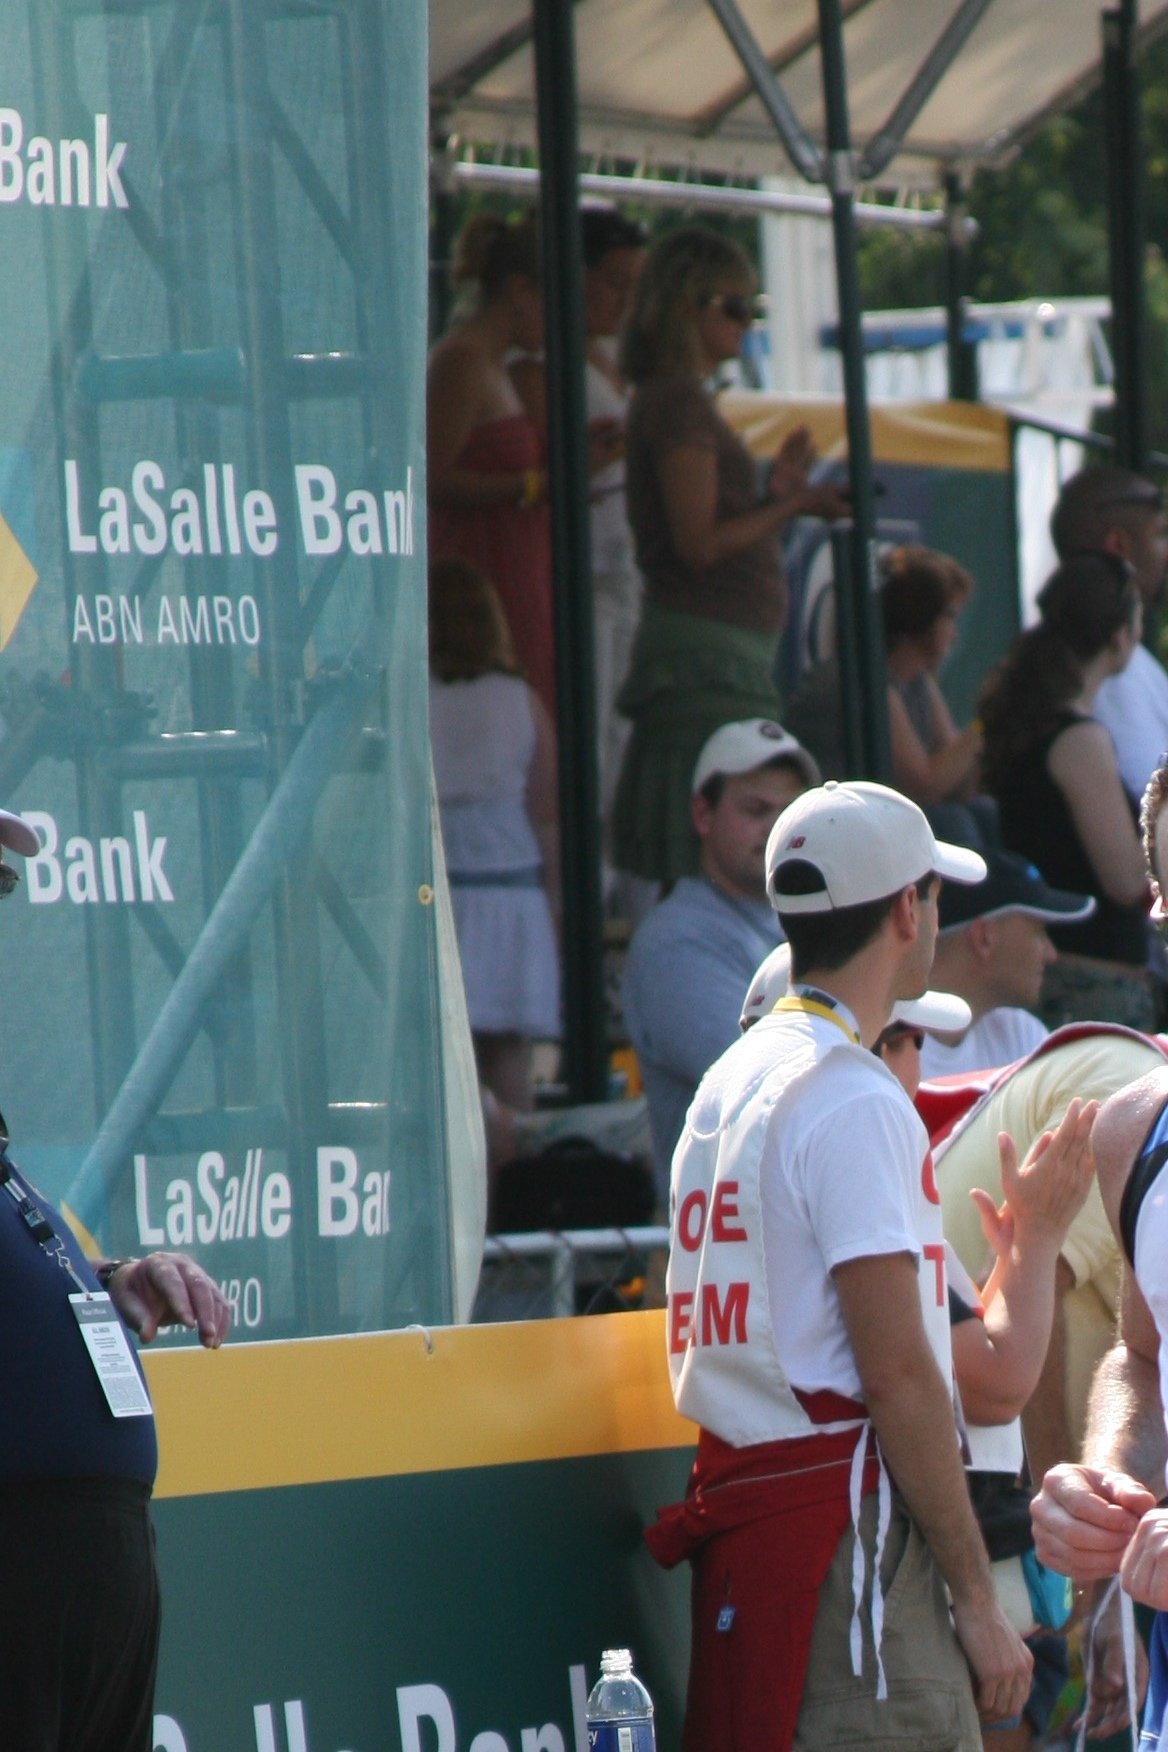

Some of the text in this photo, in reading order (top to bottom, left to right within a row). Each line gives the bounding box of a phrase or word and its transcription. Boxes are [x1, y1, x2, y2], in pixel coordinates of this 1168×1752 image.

[64, 459, 278, 556] LaSalle
[72, 593, 261, 645] ABN AMRO
[20, 810, 175, 905] Bank
[133, 1148, 292, 1247] LaSalle
